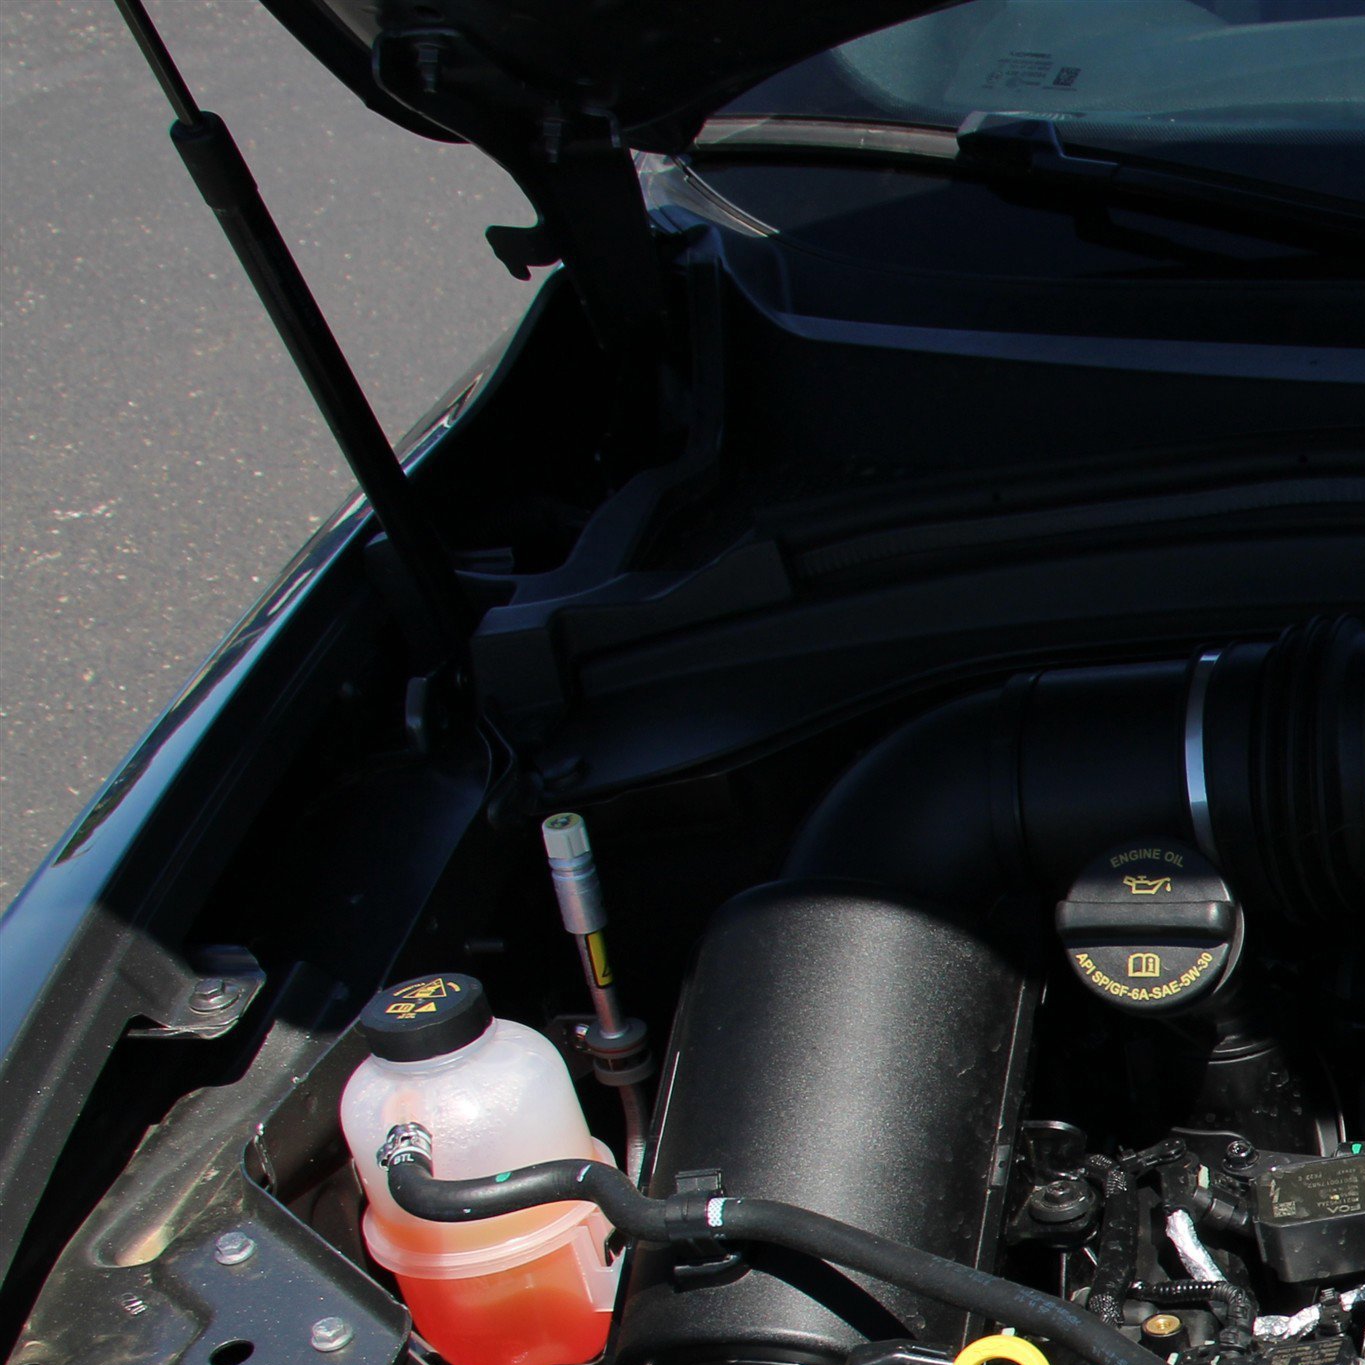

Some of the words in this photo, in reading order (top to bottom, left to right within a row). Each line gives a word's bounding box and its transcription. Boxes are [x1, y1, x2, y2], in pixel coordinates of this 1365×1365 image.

[1110, 848, 1160, 868] ENGINE
[1164, 850, 1185, 868] OIL
[1076, 952, 1093, 975] API
[393, 1152, 415, 1166] BTL
